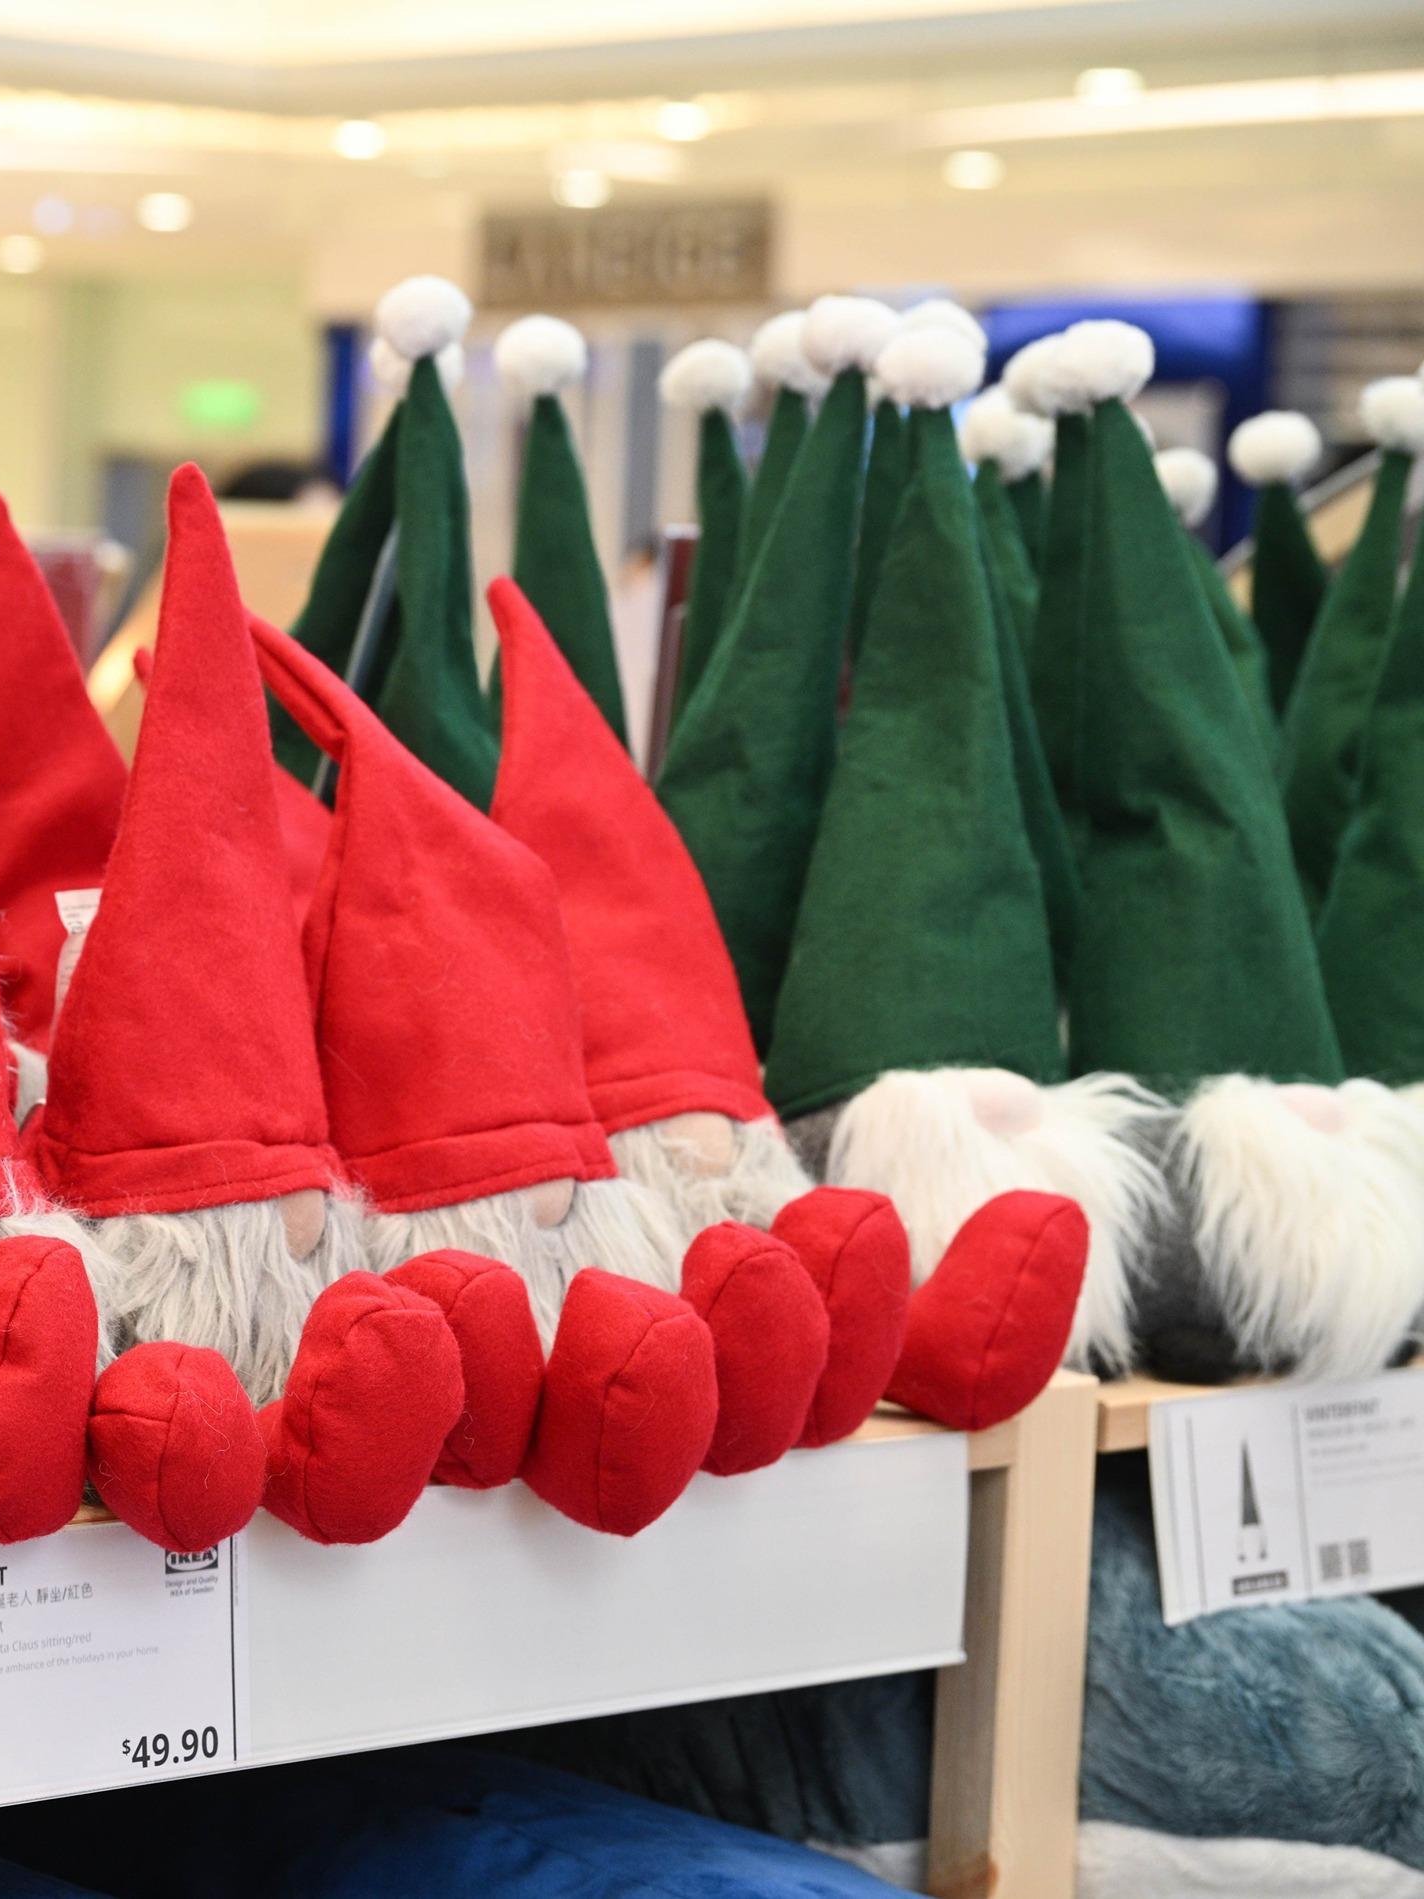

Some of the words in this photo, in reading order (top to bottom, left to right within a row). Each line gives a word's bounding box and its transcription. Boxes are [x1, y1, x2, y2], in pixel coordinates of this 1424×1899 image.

[170, 1550, 214, 1565] IKEA
[12, 1639, 39, 1652] Claus
[41, 1631, 92, 1650] sitting/red
[122, 1726, 219, 1769] $49.90
